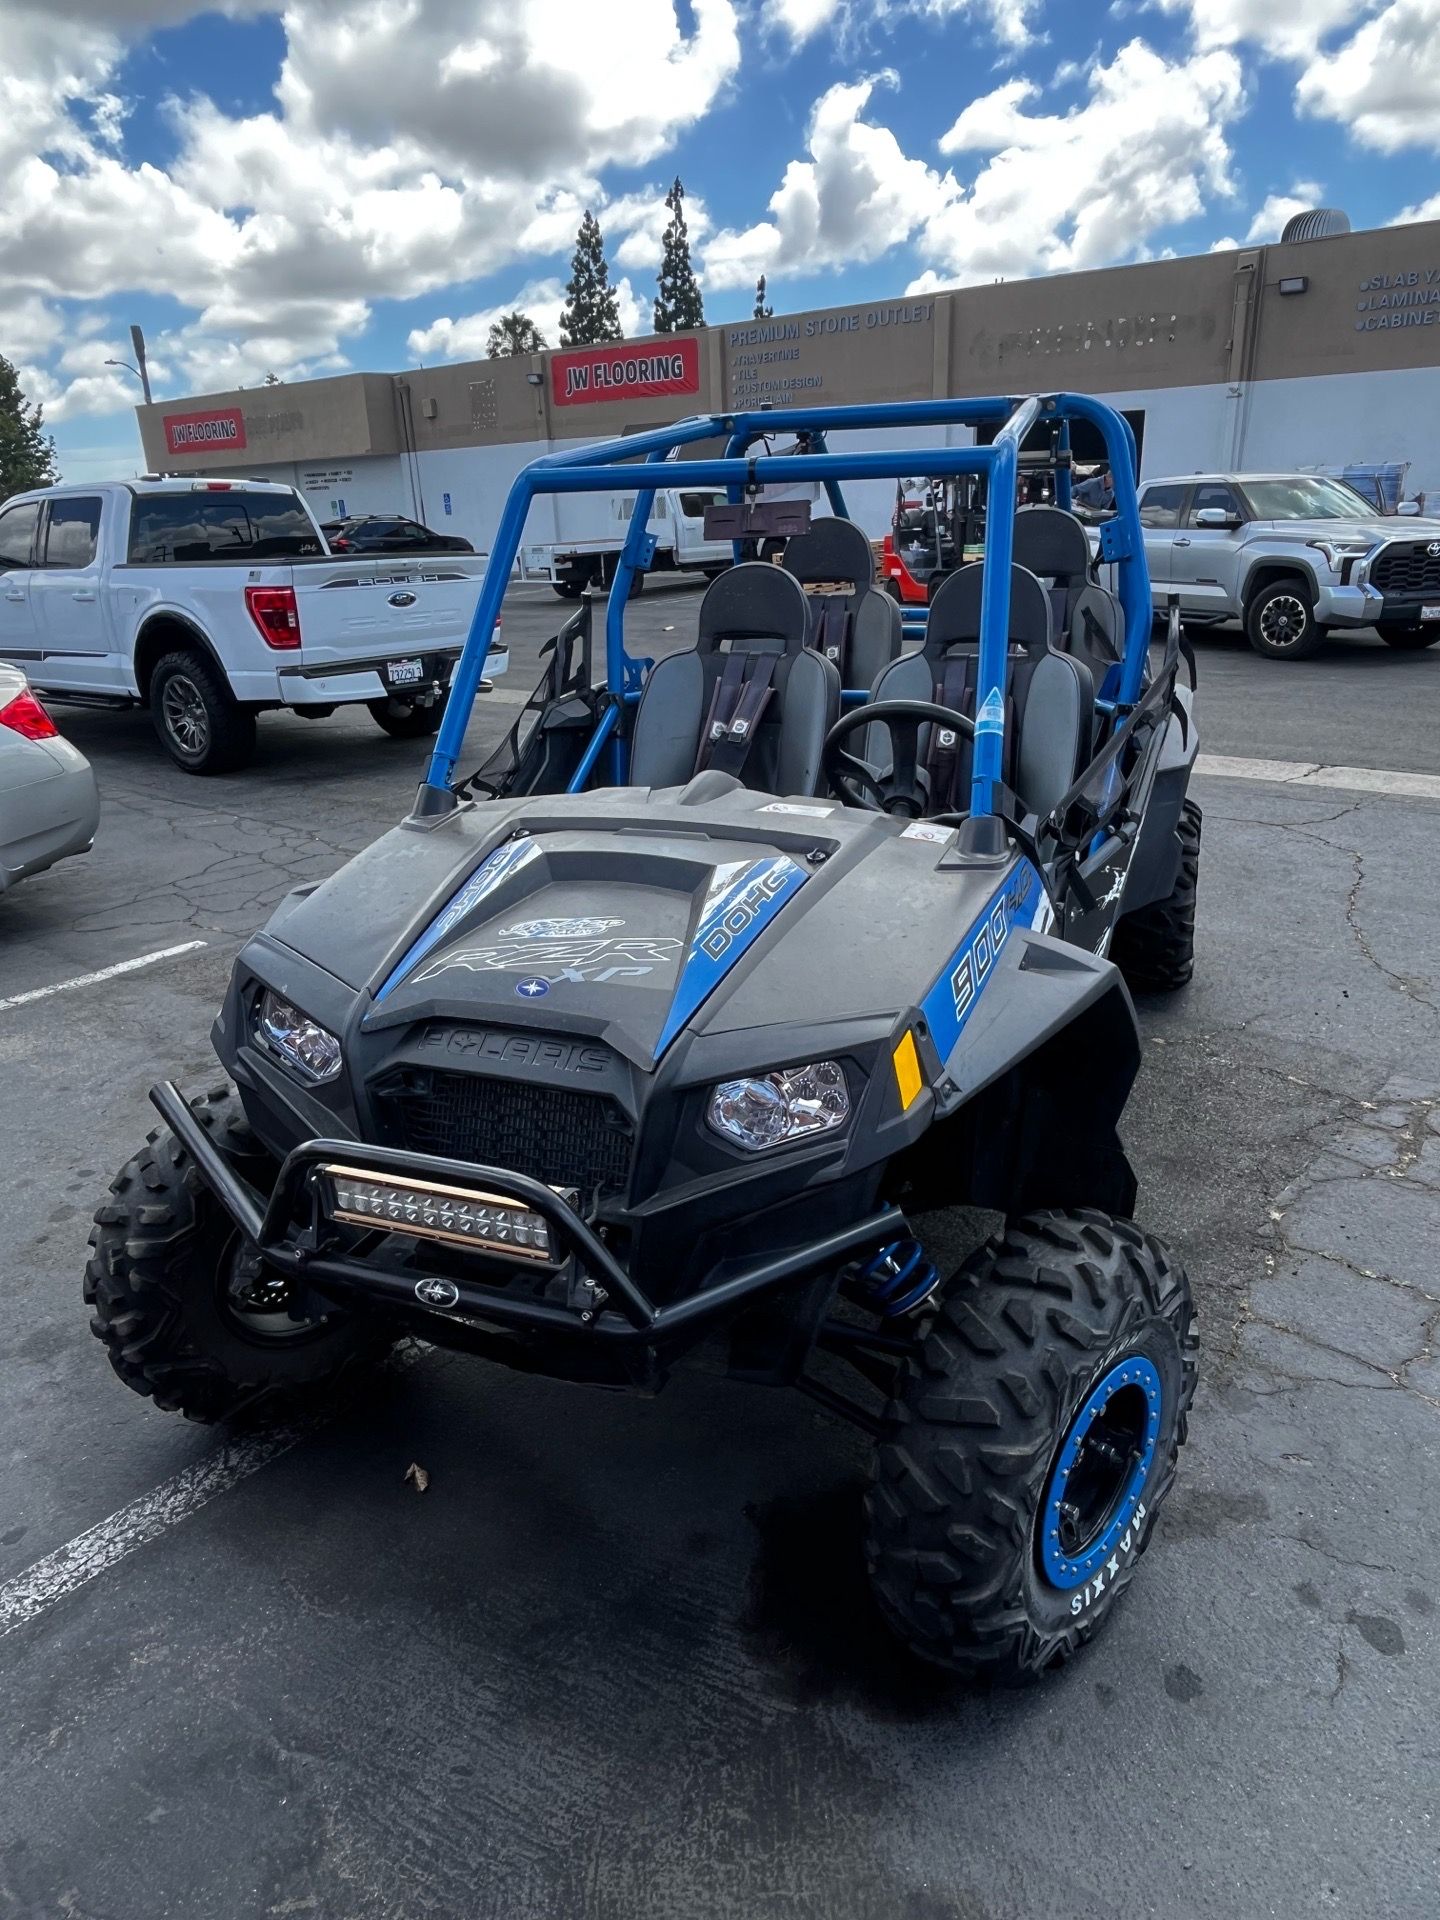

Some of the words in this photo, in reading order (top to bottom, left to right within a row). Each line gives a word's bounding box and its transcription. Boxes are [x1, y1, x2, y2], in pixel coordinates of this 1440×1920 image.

[1369, 271, 1418, 290] SLAB
[730, 322, 800, 347] PREMIUM
[806, 313, 860, 337] STONE
[866, 303, 935, 328] OUTLET
[565, 364, 589, 397] JW
[593, 353, 684, 389] FLOORING
[737, 347, 800, 367] TRAVERTINE
[739, 369, 758, 381] TILE
[738, 379, 781, 395] CUSTOM
[783, 375, 823, 389] DESIGN
[172, 424, 187, 448] JW
[186, 419, 237, 442] FLOORING
[357, 575, 439, 586] ROUSH
[700, 869, 789, 962] DOHC
[410, 937, 684, 985] RZR
[549, 965, 655, 984] XP
[950, 893, 1008, 1022] 900
[418, 1026, 612, 1074] POLARIS
[1070, 1502, 1147, 1616] MAXXIS
